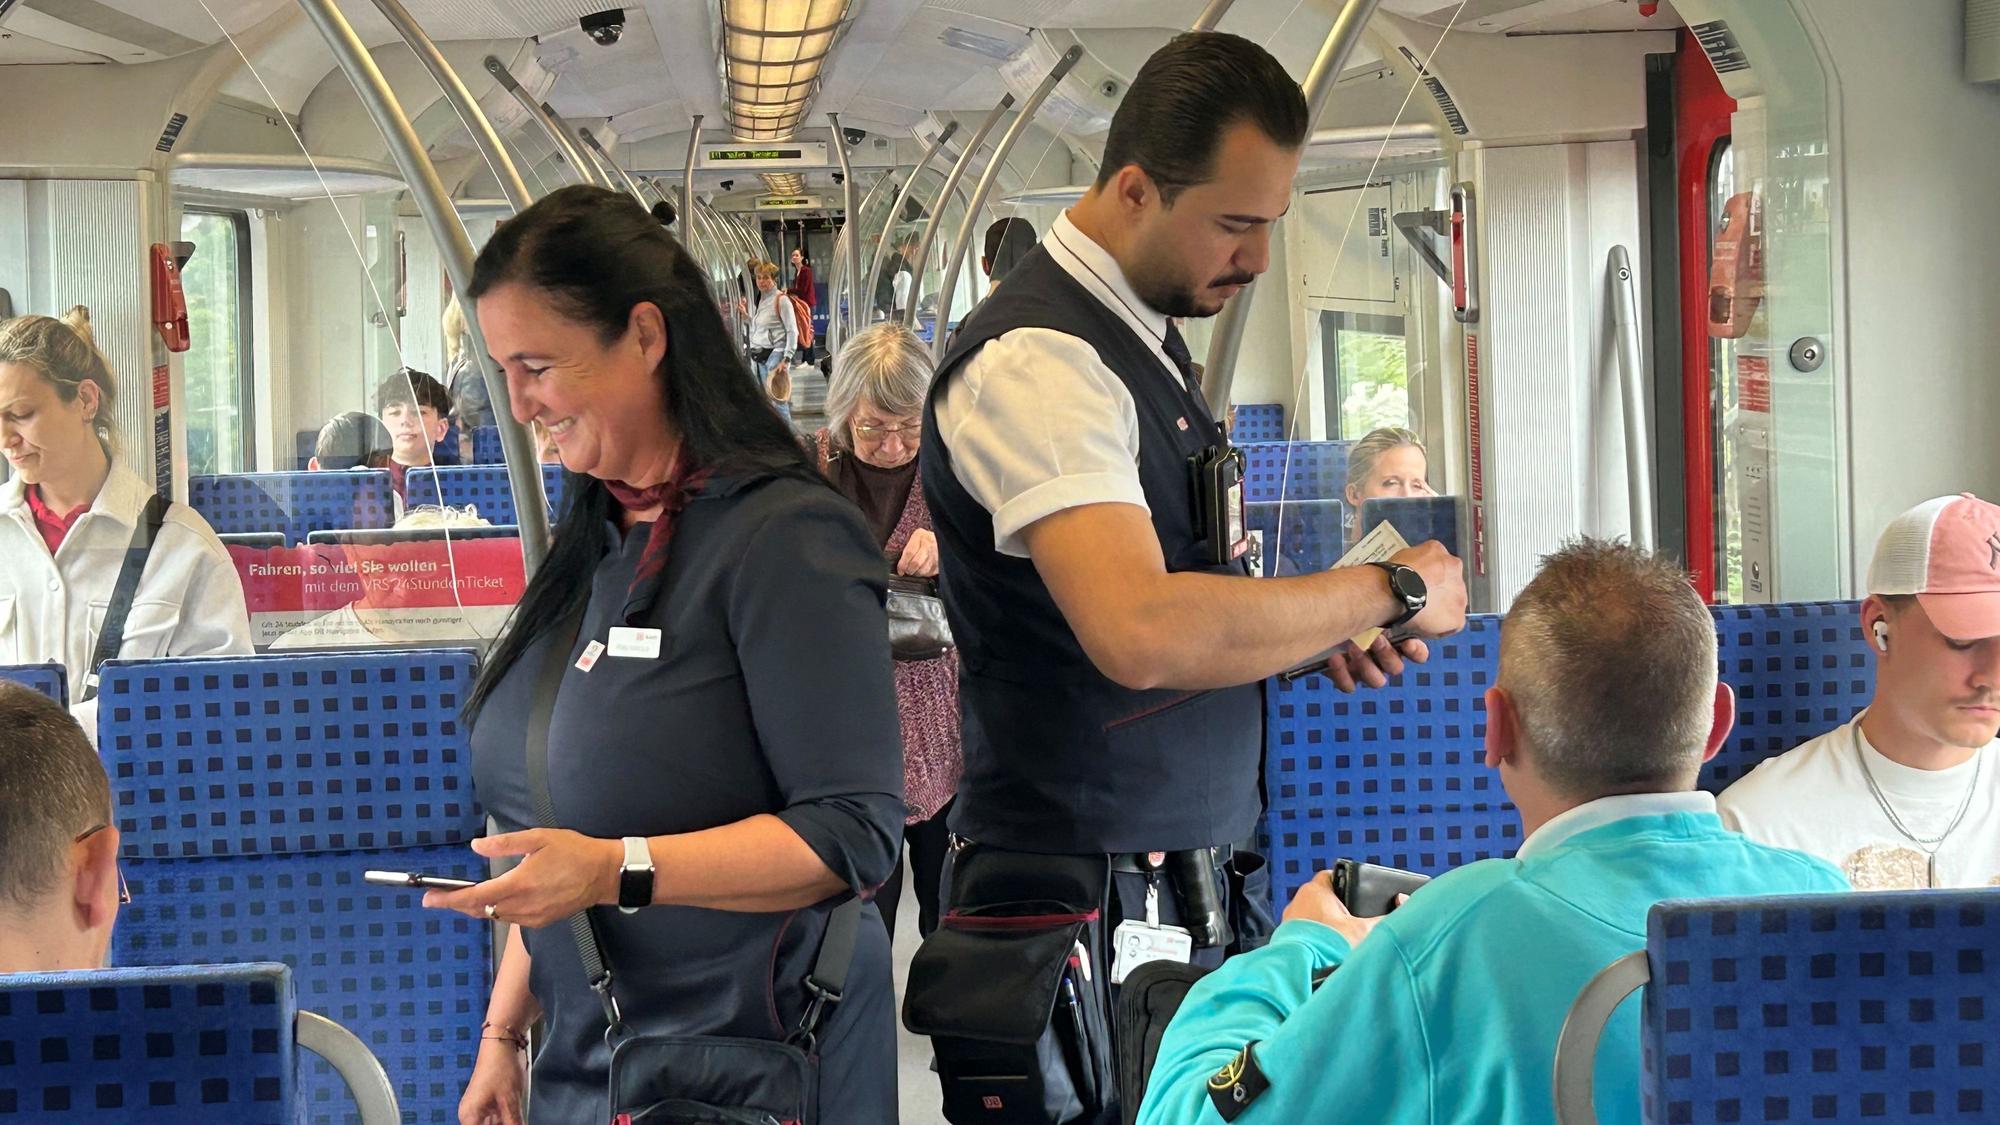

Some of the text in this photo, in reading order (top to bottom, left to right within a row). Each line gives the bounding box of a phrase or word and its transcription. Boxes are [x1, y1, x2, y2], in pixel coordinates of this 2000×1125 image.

[249, 563, 307, 577] Fahren,
[309, 564, 327, 575] so
[333, 560, 358, 575] viel
[361, 560, 385, 574] Sie
[387, 560, 437, 573] wollen
[304, 580, 326, 593] mit
[329, 579, 360, 593] dem
[362, 577, 390, 592] VRS
